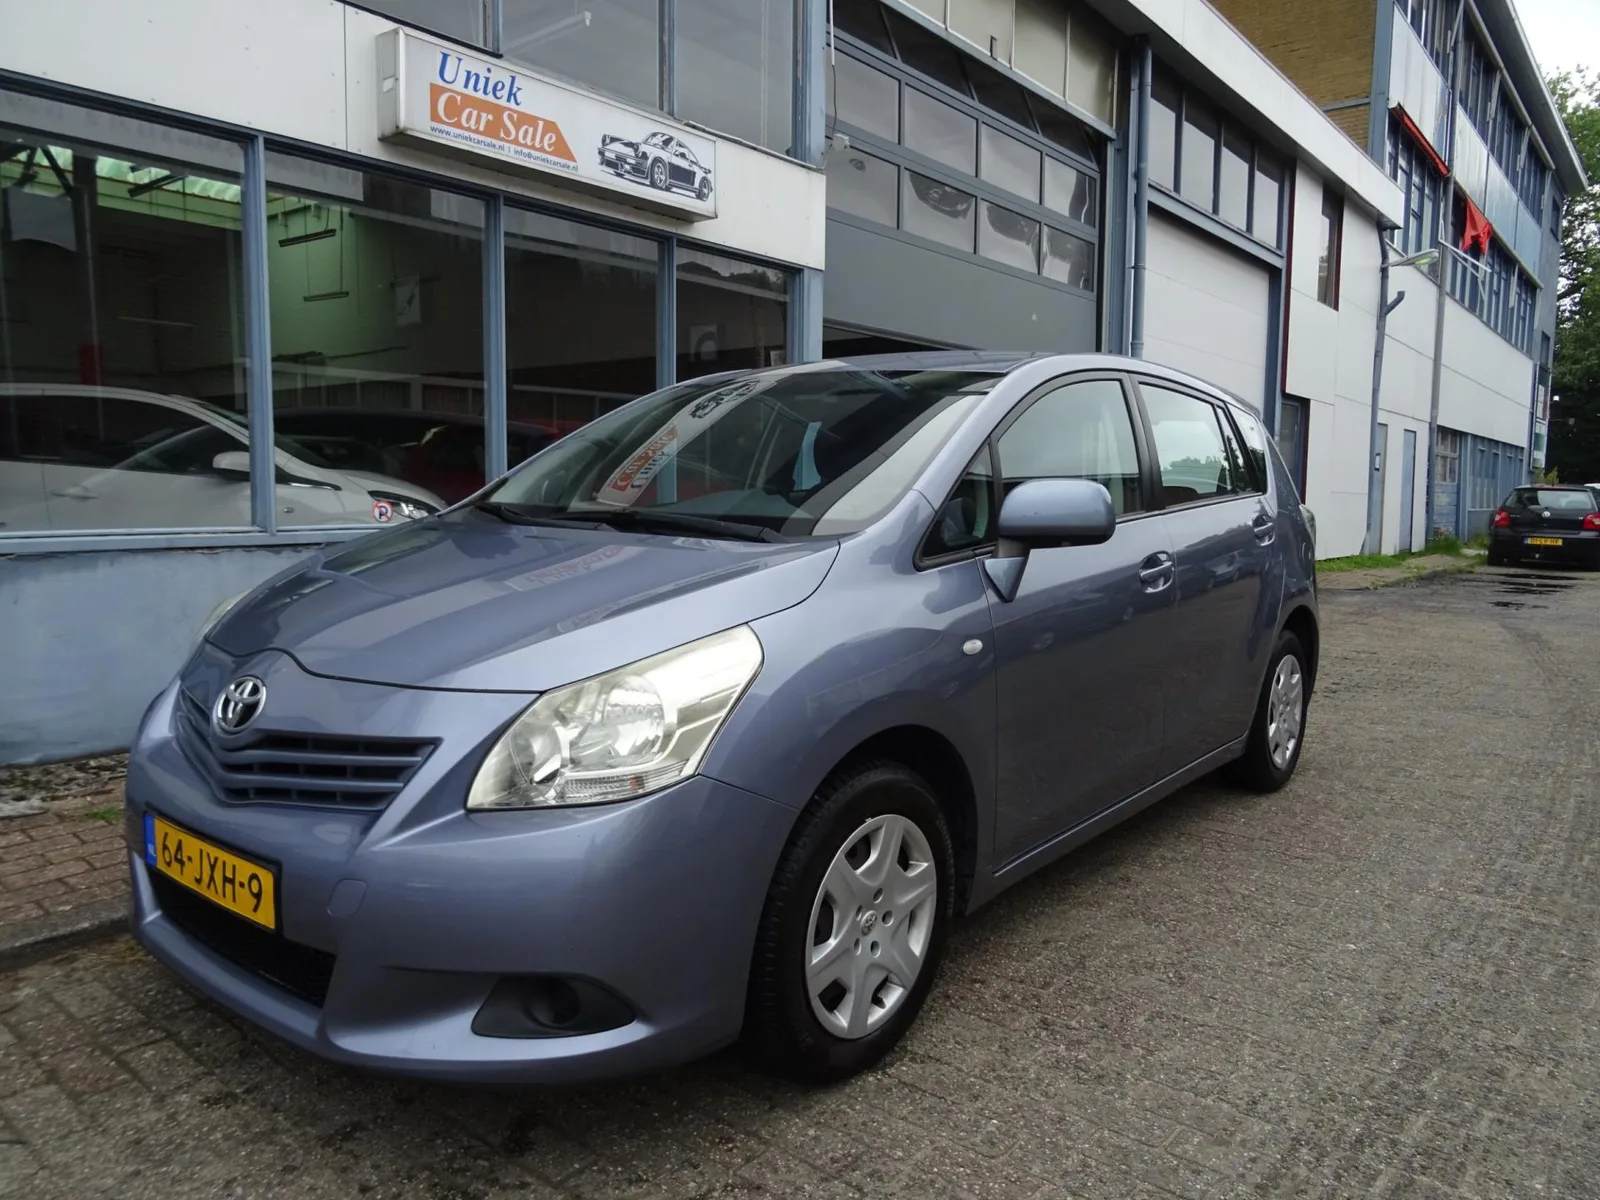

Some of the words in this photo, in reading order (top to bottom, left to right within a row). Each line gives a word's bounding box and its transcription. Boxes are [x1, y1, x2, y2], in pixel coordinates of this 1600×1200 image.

[438, 51, 523, 106] Uniek
[430, 124, 505, 152] www.uniekcarsale.nl
[513, 148, 579, 172] info@uniekcarsale.nl
[437, 92, 494, 132] Car
[500, 110, 557, 152] Sale
[161, 831, 263, 914] 64-JXH-9
